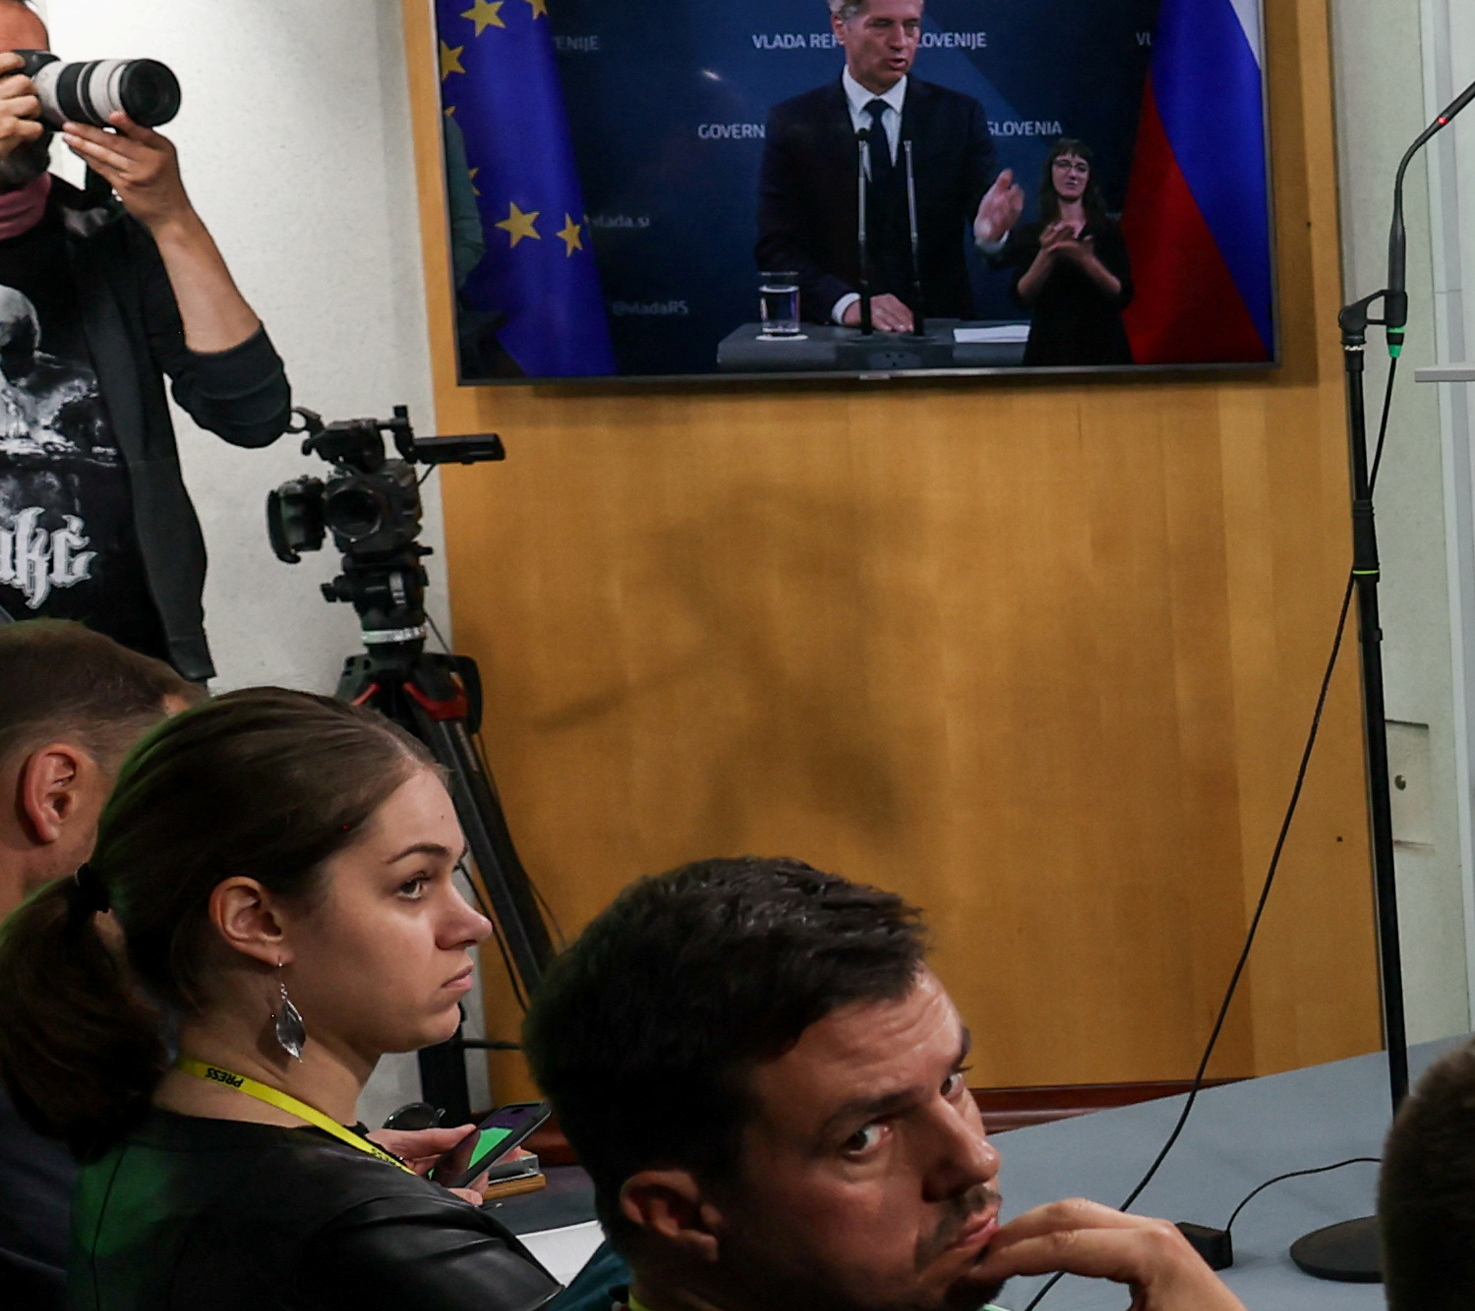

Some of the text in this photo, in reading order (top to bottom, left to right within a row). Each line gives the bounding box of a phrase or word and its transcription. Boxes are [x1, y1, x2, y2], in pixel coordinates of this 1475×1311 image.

[751, 33, 806, 50] VLADA
[698, 123, 765, 139] GOVERN
[206, 1067, 244, 1088] PRESS
